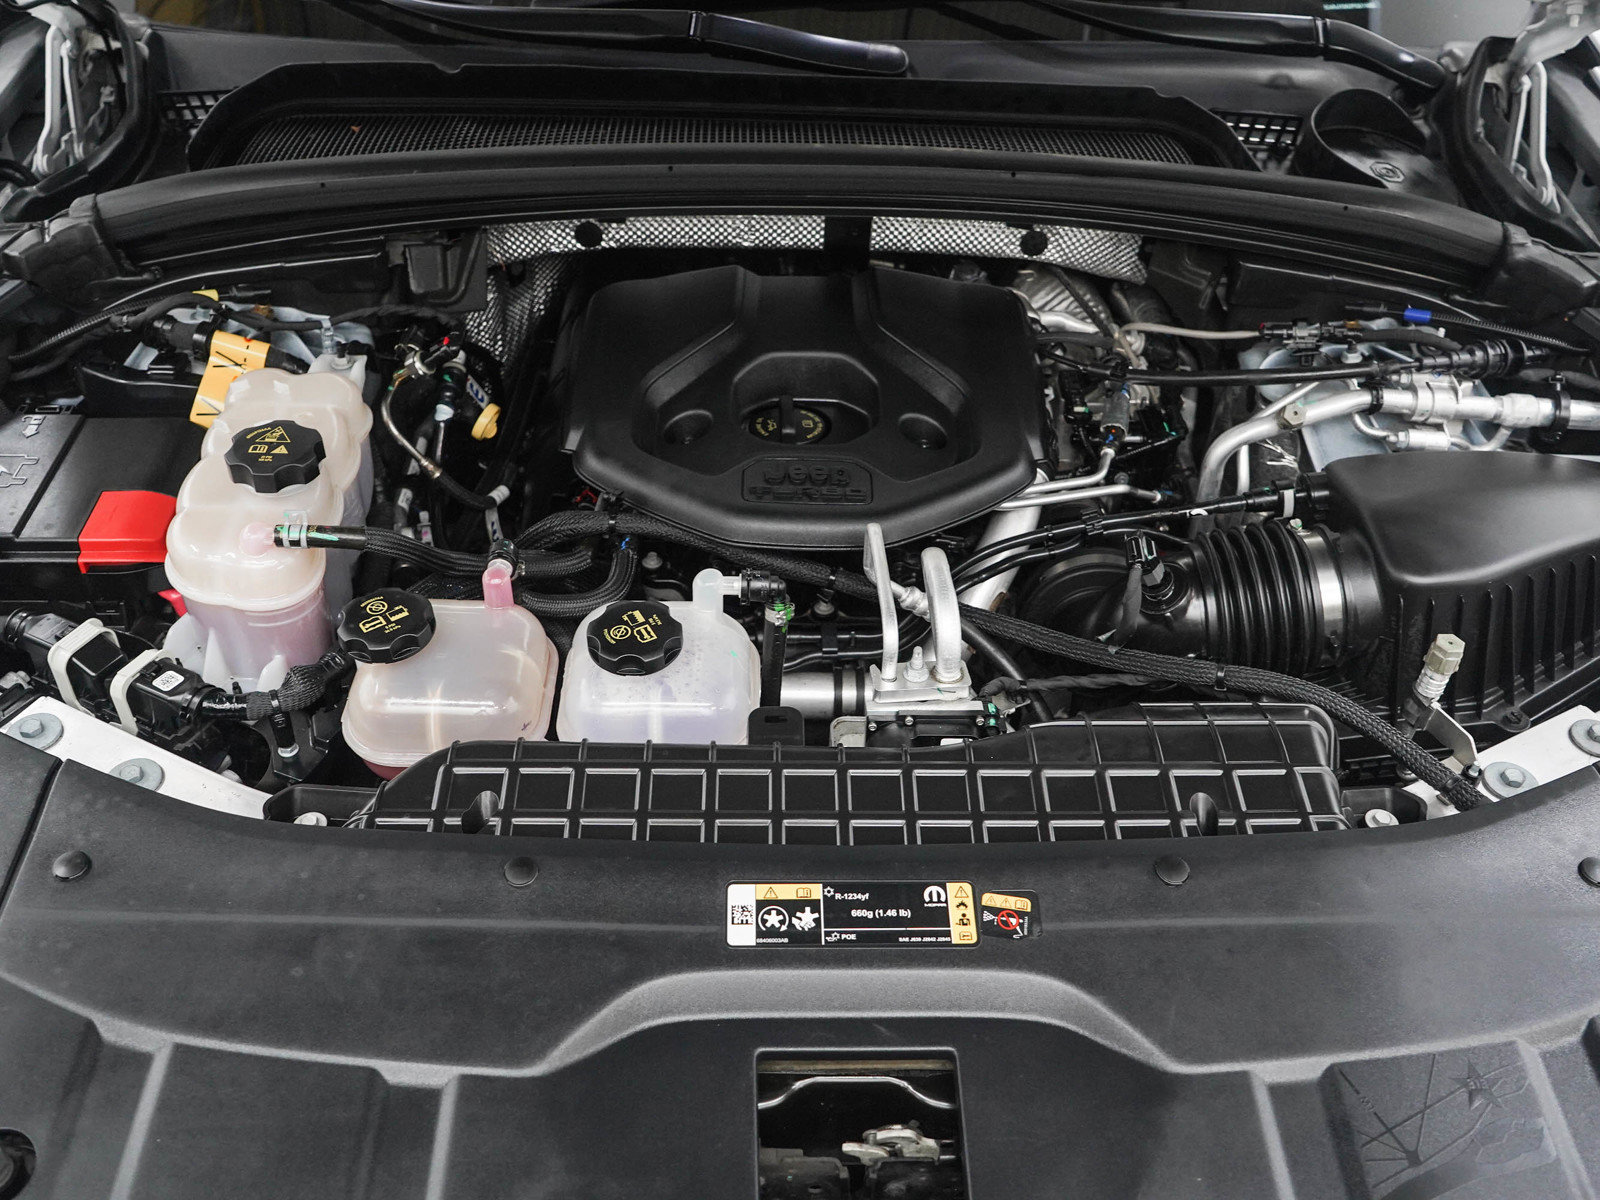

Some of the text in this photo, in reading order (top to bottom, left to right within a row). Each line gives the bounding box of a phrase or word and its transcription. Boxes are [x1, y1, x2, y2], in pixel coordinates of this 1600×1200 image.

[835, 892, 870, 902] R-1234yf
[851, 909, 911, 918] 660g (1.46 lb)
